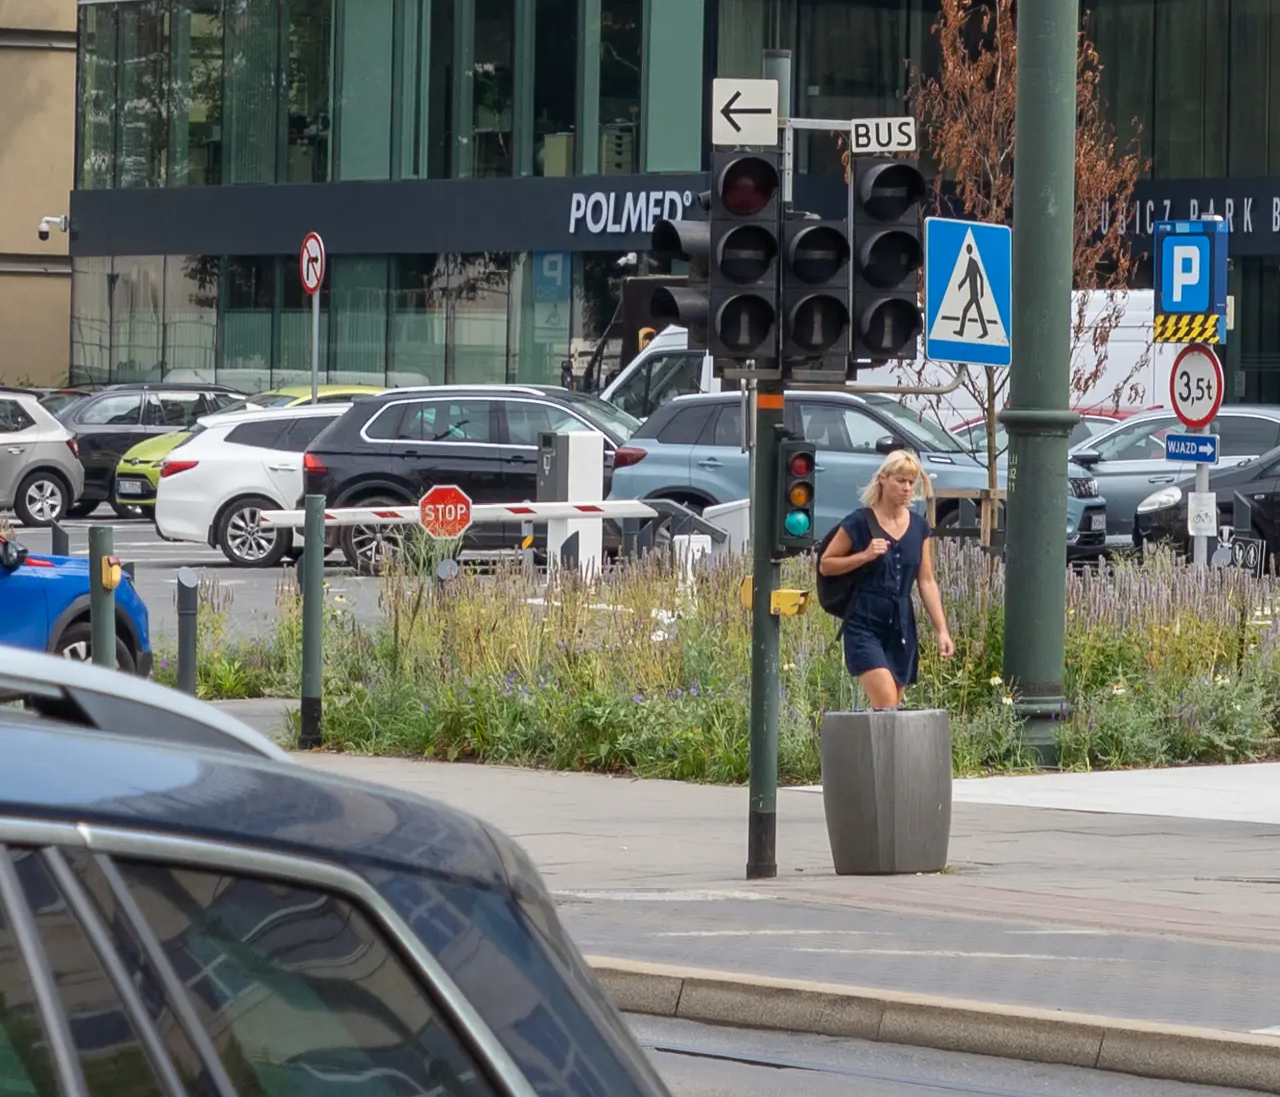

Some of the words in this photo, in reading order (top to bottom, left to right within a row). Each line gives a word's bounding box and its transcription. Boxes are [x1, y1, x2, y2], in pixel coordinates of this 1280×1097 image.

[854, 121, 912, 148] BUS
[1272, 197, 1280, 232] B
[1172, 245, 1201, 302] P
[1178, 370, 1213, 406] 3,5t
[1167, 439, 1197, 456] WJAZD
[425, 504, 467, 522] STOP
